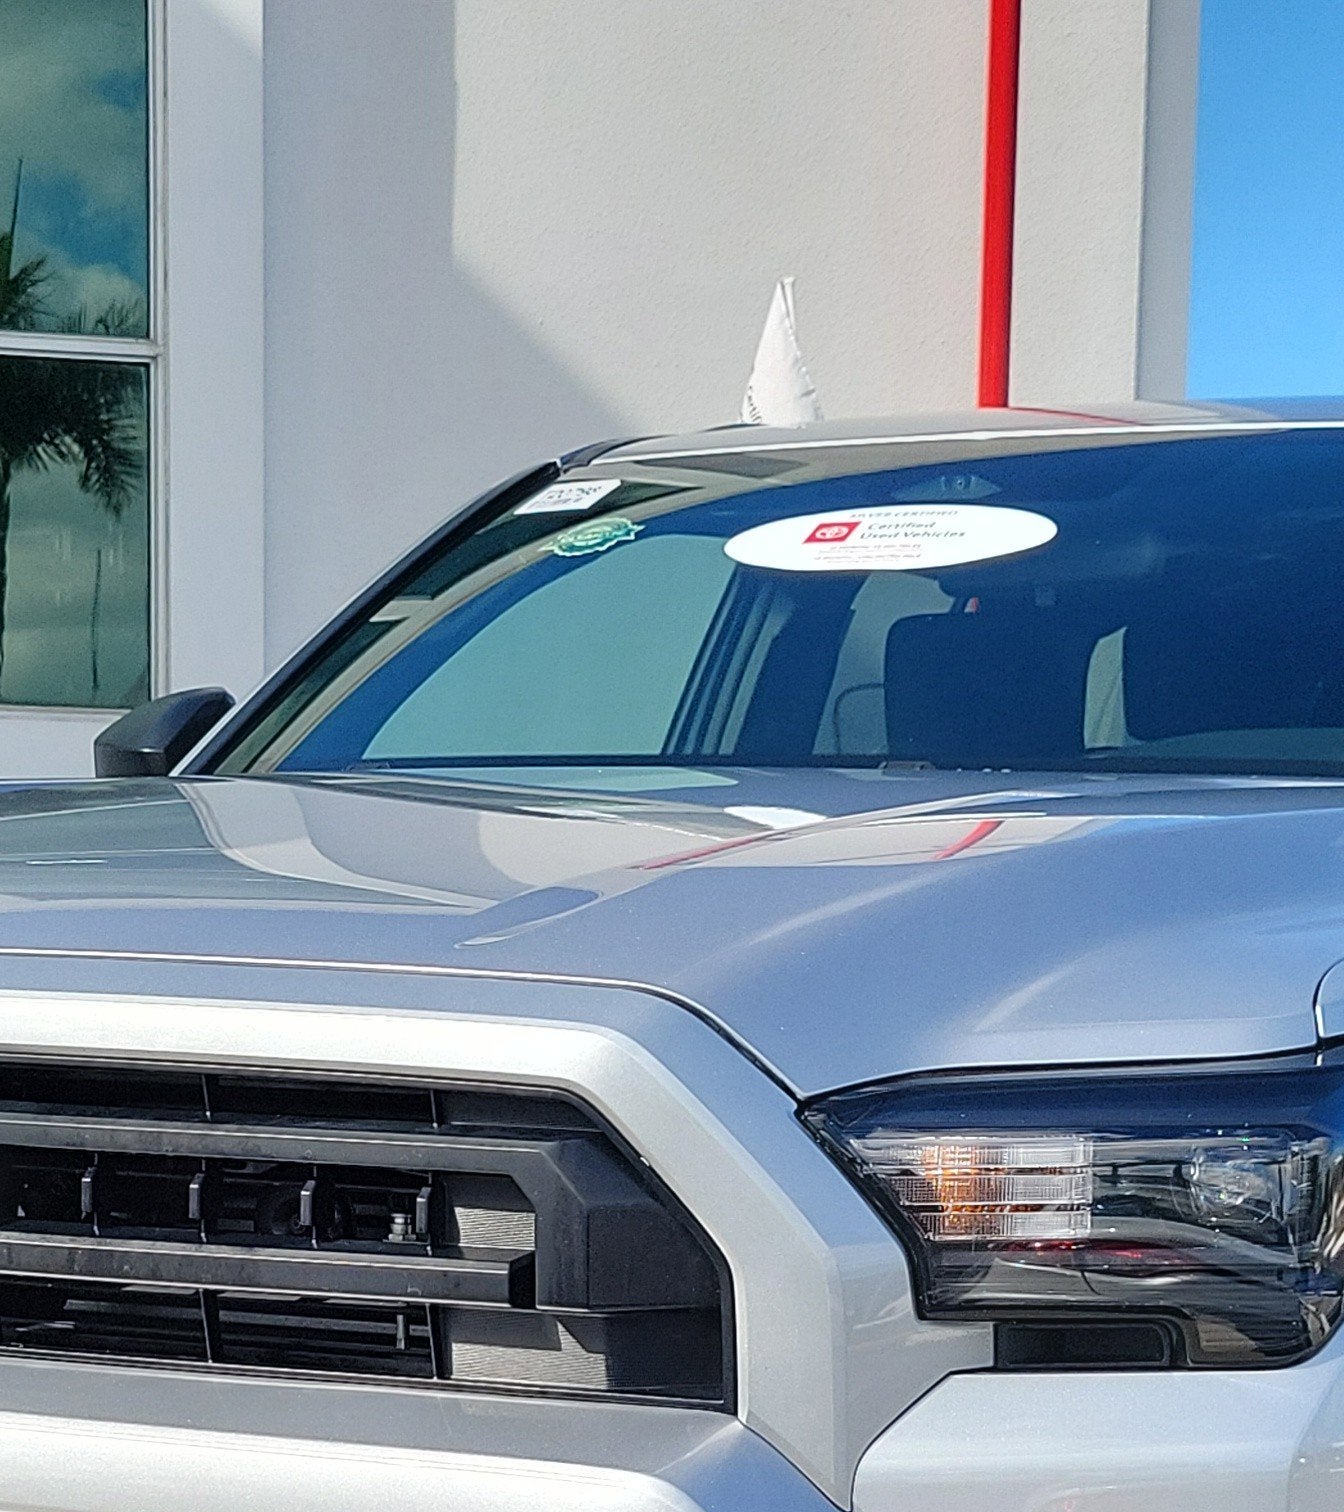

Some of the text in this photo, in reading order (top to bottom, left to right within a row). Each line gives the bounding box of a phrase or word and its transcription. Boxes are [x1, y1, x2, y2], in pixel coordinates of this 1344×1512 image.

[868, 521, 937, 530] Certified
[860, 530, 967, 540] Used Vehicles
